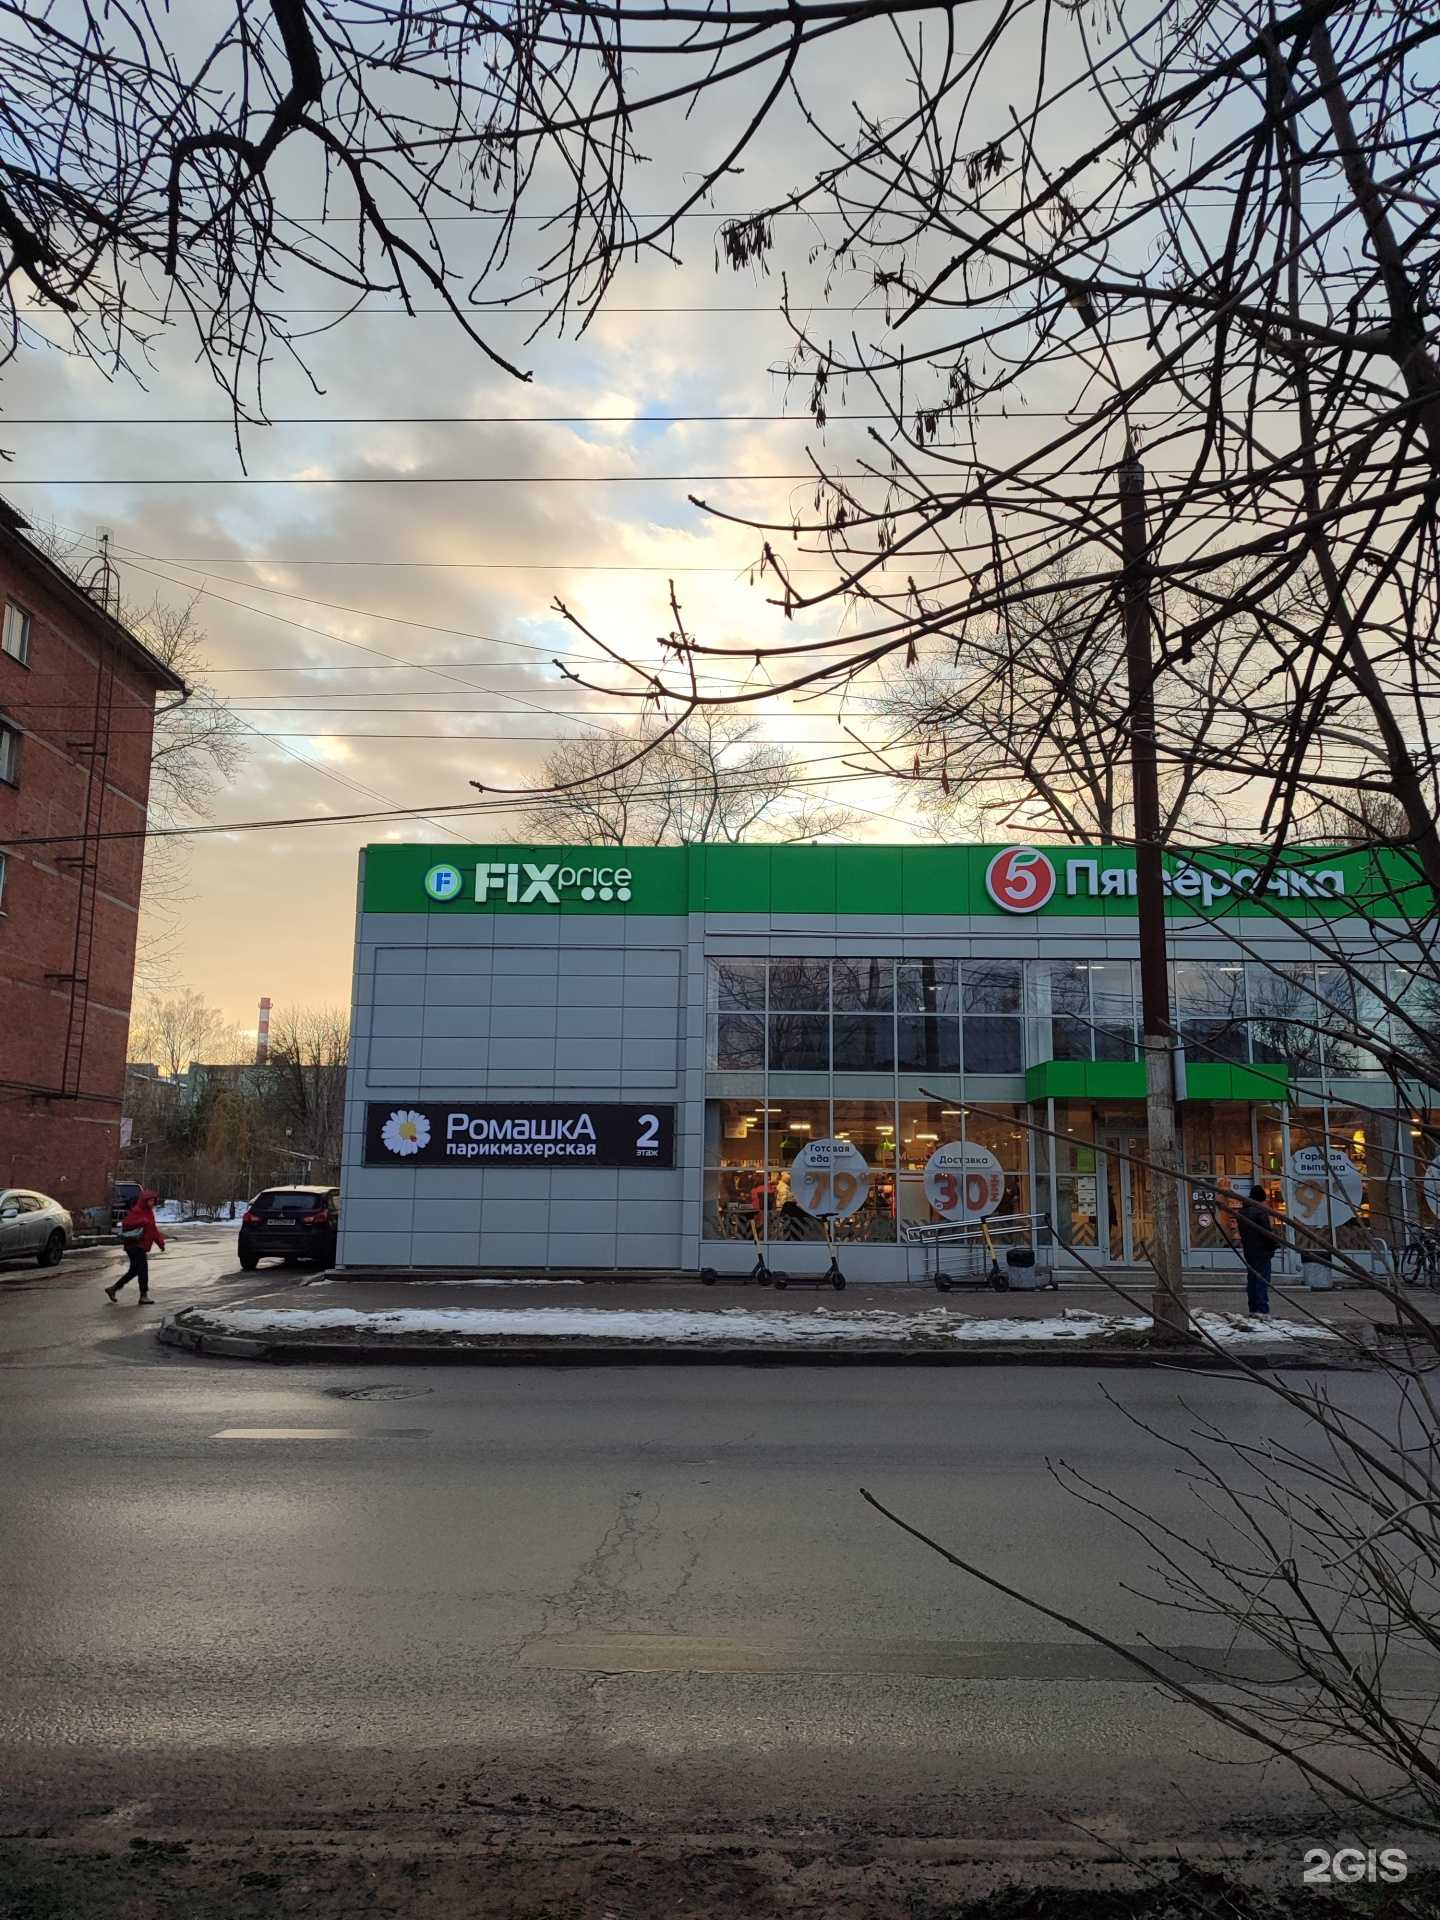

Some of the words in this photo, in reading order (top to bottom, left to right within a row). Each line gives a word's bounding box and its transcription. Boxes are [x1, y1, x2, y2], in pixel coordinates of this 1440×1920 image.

[435, 872, 451, 892] F
[558, 867, 632, 890] price
[1004, 851, 1040, 900] 5
[636, 1114, 659, 1147] 2
[446, 1142, 597, 1158] парикмахерская
[810, 1154, 829, 1163] еда
[1300, 1152, 1342, 1162] Горяая
[934, 1172, 989, 1212] 30
